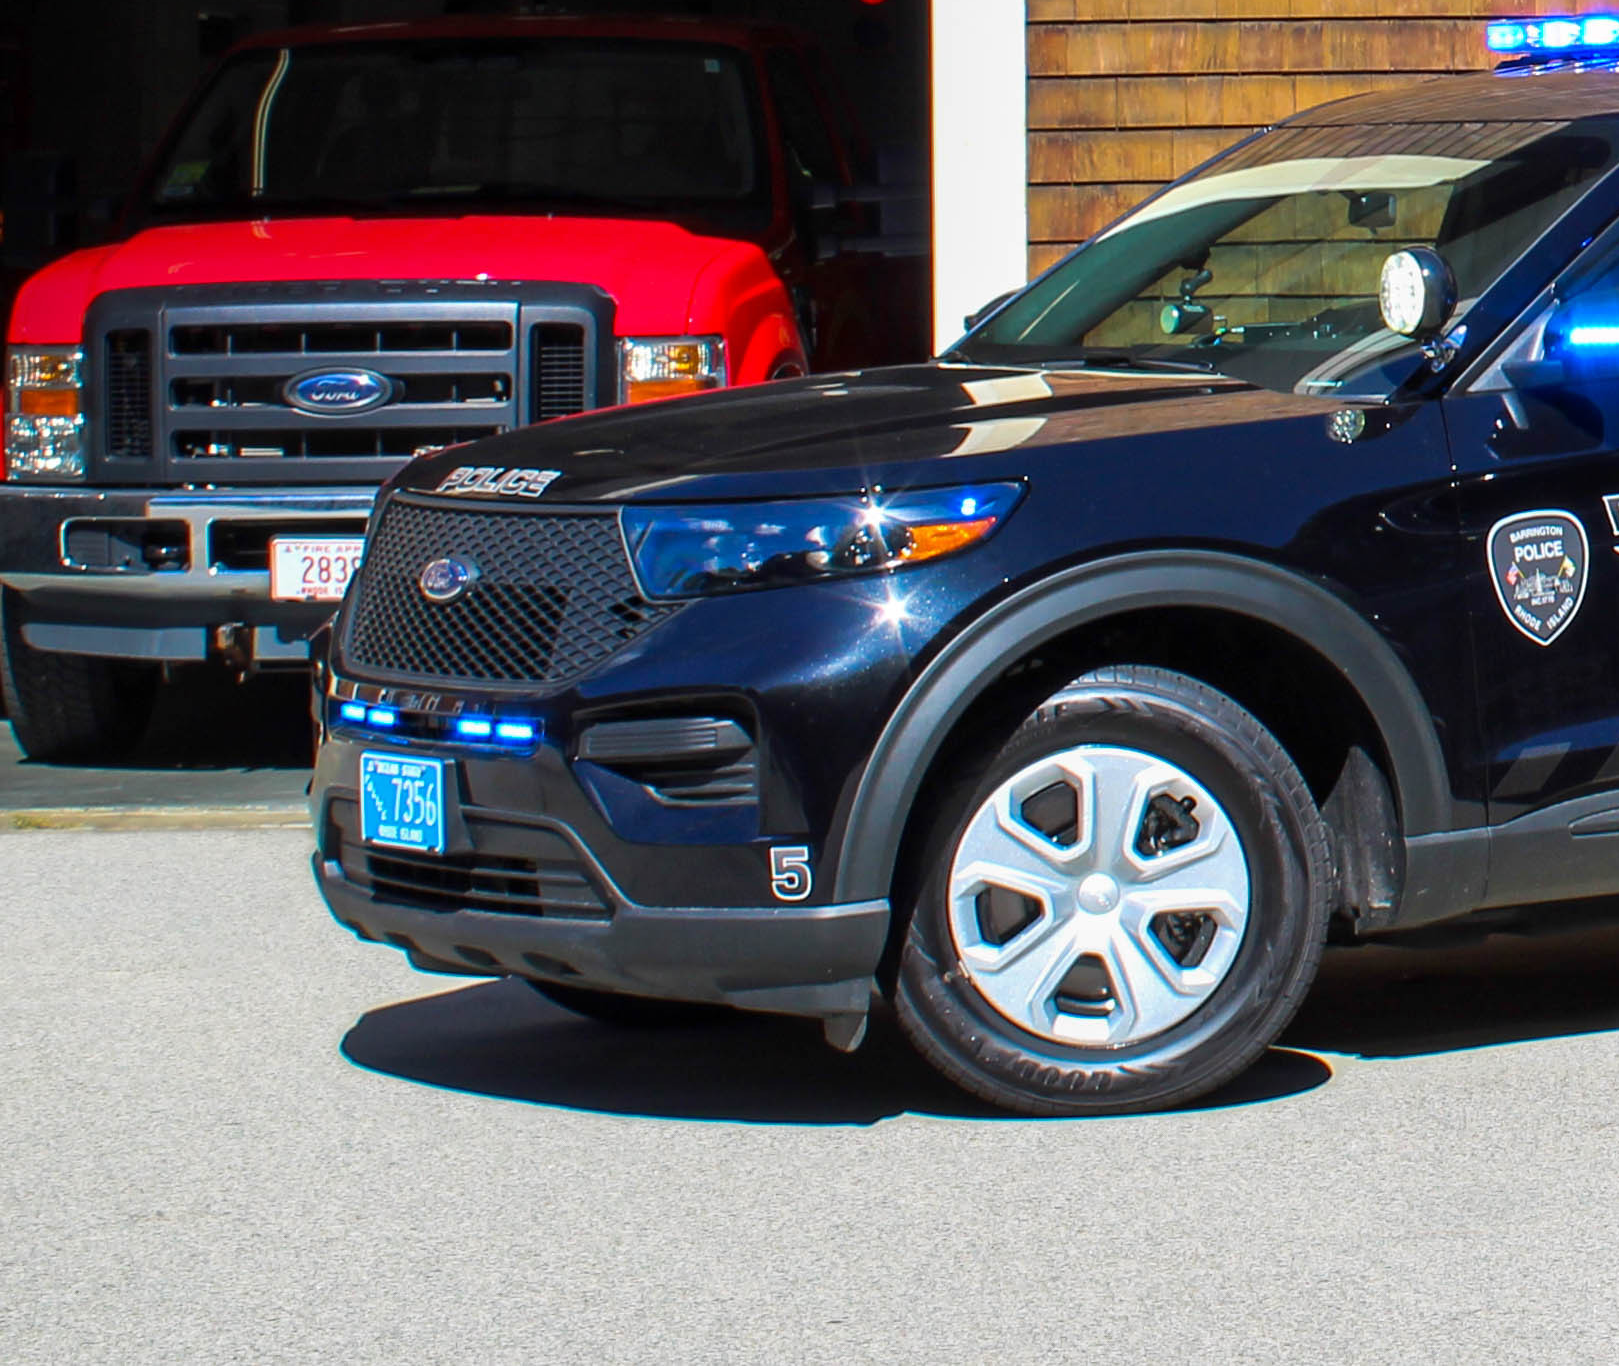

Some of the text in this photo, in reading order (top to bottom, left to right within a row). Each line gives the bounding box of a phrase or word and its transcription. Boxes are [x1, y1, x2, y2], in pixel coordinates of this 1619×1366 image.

[435, 466, 562, 498] POLICE
[1509, 525, 1564, 544] BARRINGTON
[1514, 540, 1564, 563] POLICE
[1514, 596, 1575, 632] RHODE ISLAND
[391, 777, 437, 827] 7356
[769, 845, 812, 901] 5
